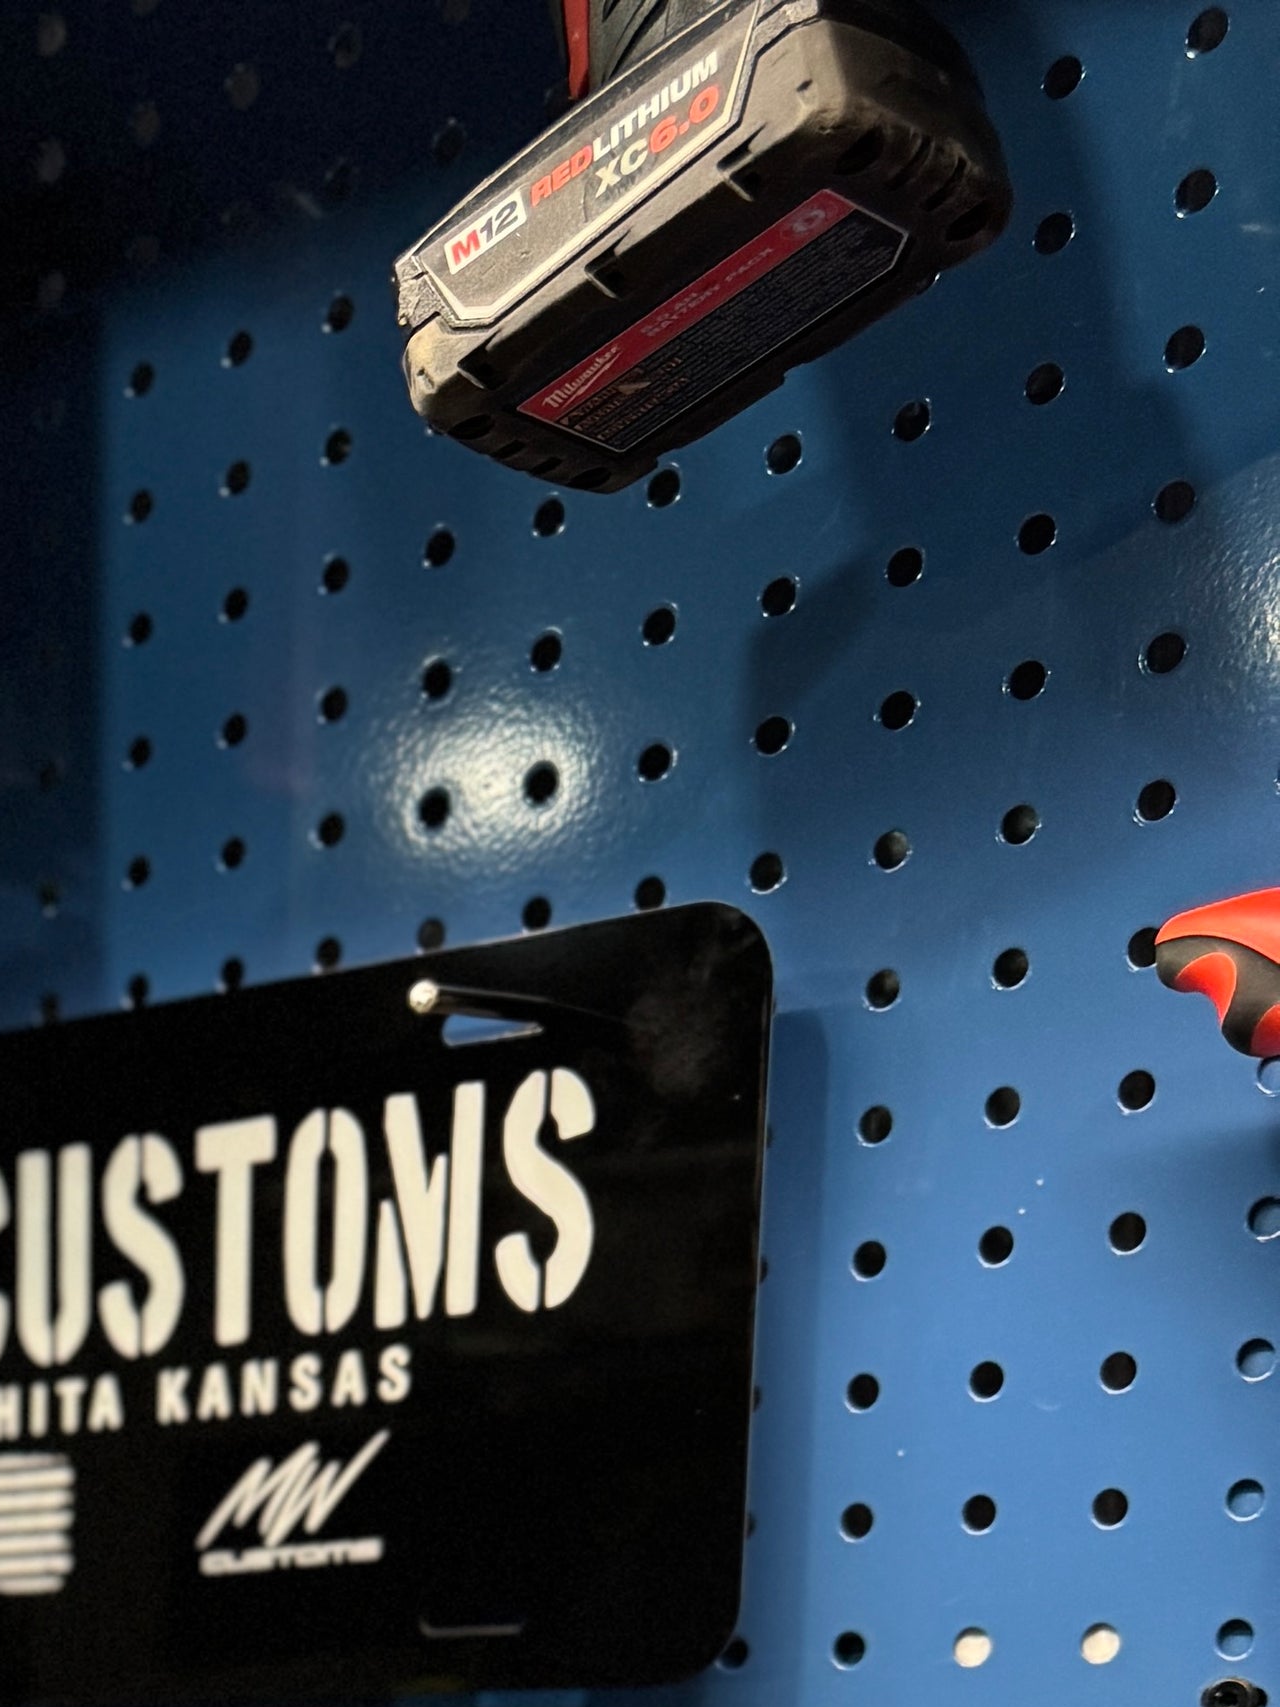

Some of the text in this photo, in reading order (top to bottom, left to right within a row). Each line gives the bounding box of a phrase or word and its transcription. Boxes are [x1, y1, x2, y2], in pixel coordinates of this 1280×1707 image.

[448, 50, 719, 268] M12 REDLITHIUM
[594, 83, 721, 199] XC6.0
[541, 344, 620, 409] Milwaukee
[156, 1343, 413, 1425] KANSAS
[193, 1427, 392, 1552] MW
